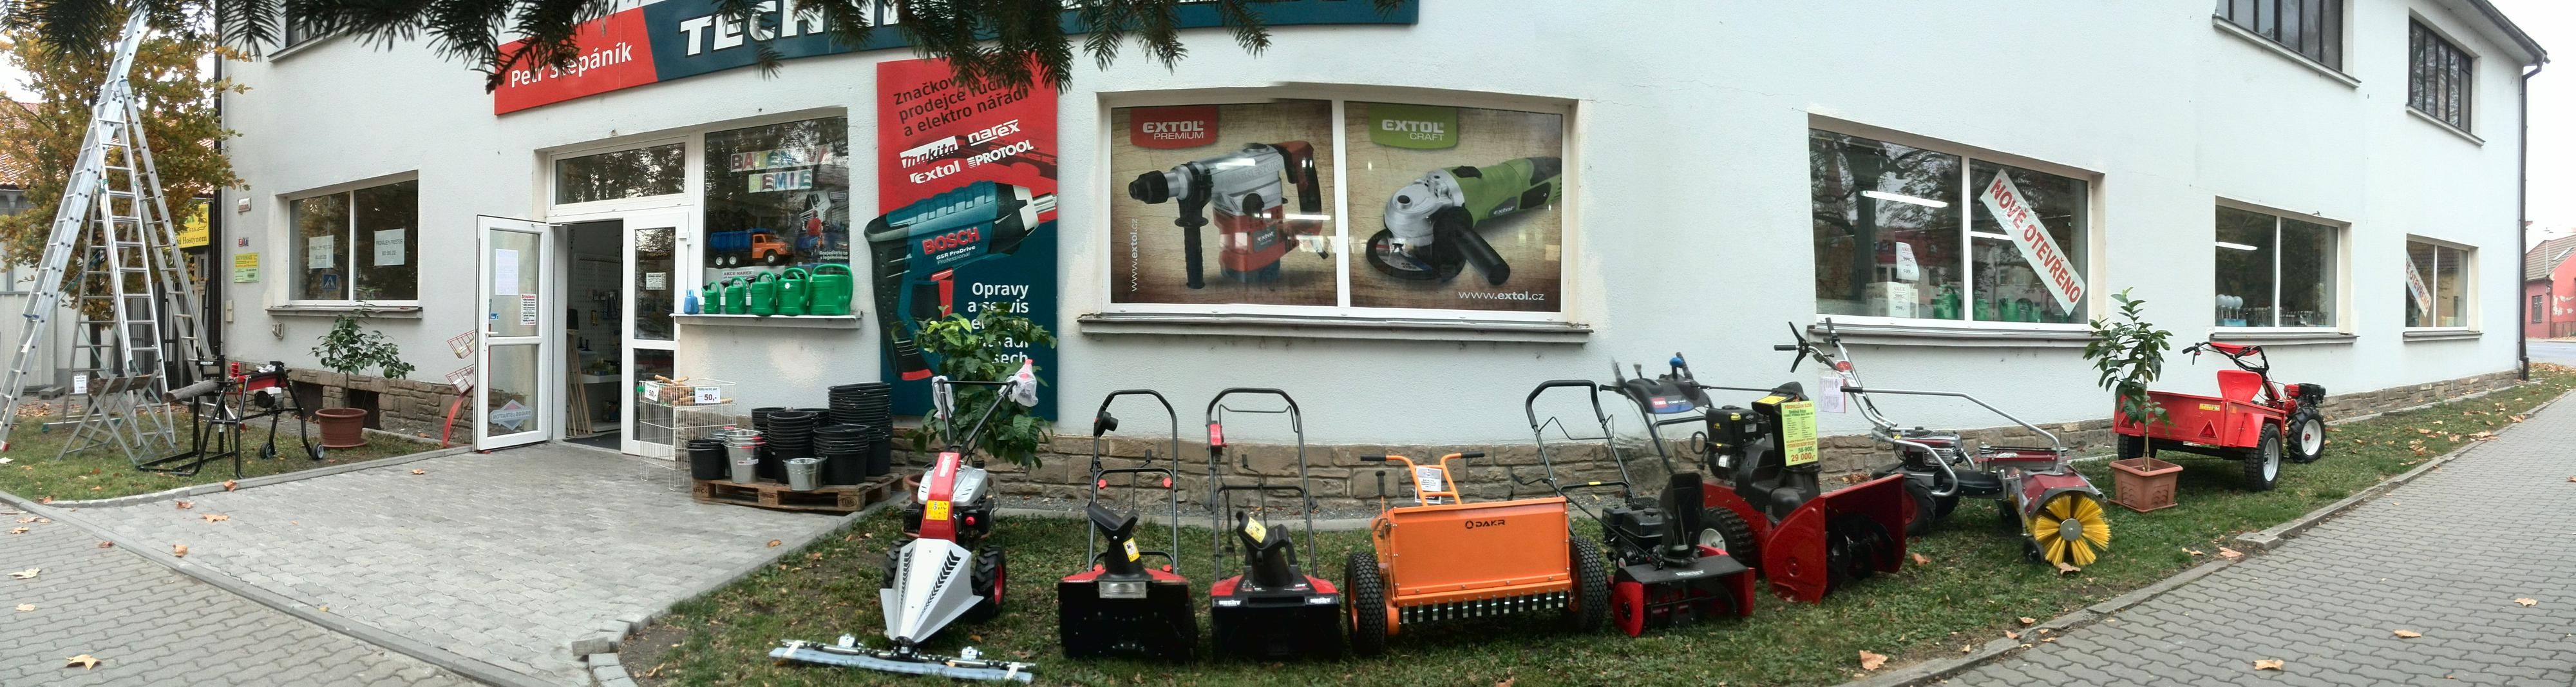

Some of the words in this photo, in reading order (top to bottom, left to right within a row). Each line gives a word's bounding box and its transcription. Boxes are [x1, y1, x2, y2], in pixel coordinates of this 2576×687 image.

[511, 66, 544, 88] Petr
[894, 77, 961, 105] Značkov
[899, 90, 966, 124] prodejce
[904, 126, 913, 137] a
[918, 106, 972, 132] elektro
[1143, 121, 1204, 133] EXTOL
[1382, 119, 1444, 133] EXTOL
[967, 119, 1020, 146] narex
[975, 140, 1034, 166] PROTOOL
[183, 236, 207, 244] Hostýnem
[922, 227, 980, 255] BOSCH
[1990, 179, 2027, 229] NOVĚ
[2023, 224, 2081, 303] OTEVŘENO
[937, 252, 970, 265] Professional
[950, 246, 976, 256] ProDrive
[1130, 218, 1138, 292] www.extol.cz
[972, 282, 1028, 299] Opravy
[1458, 291, 1544, 300] www.extol.cz
[967, 301, 976, 312] a
[981, 299, 1029, 313] sevis
[1475, 519, 1505, 528] DAKR
